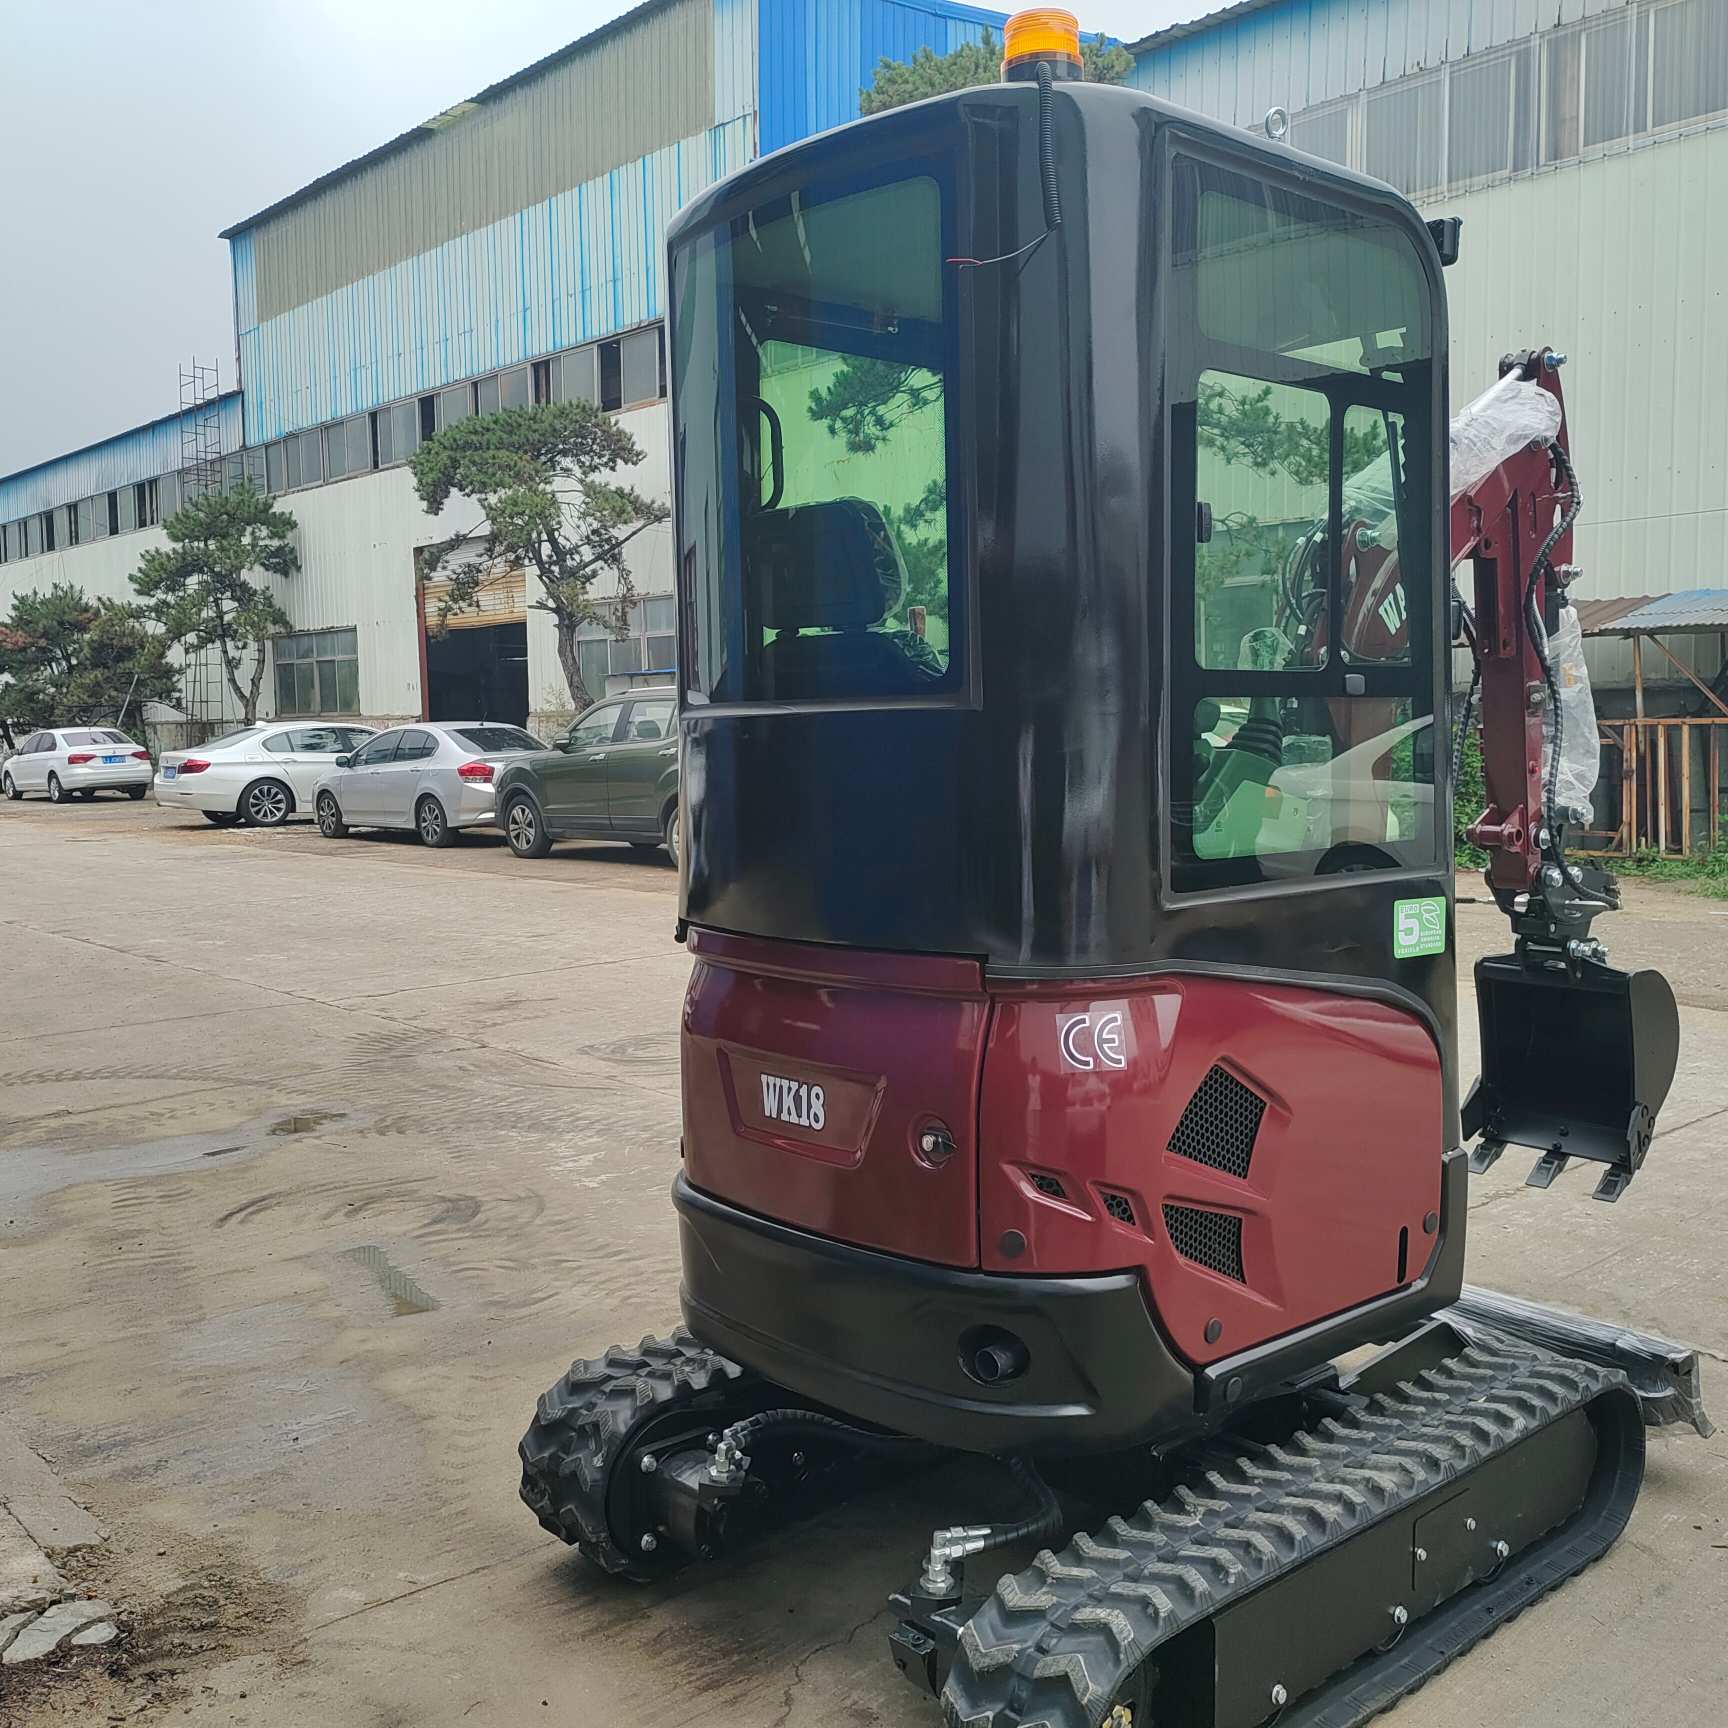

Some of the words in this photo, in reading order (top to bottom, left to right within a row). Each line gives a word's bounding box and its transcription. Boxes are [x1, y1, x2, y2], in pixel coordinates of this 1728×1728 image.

[1398, 904, 1420, 945] 5
[1060, 1013, 1125, 1069] CE
[760, 1073, 825, 1130] WK18
